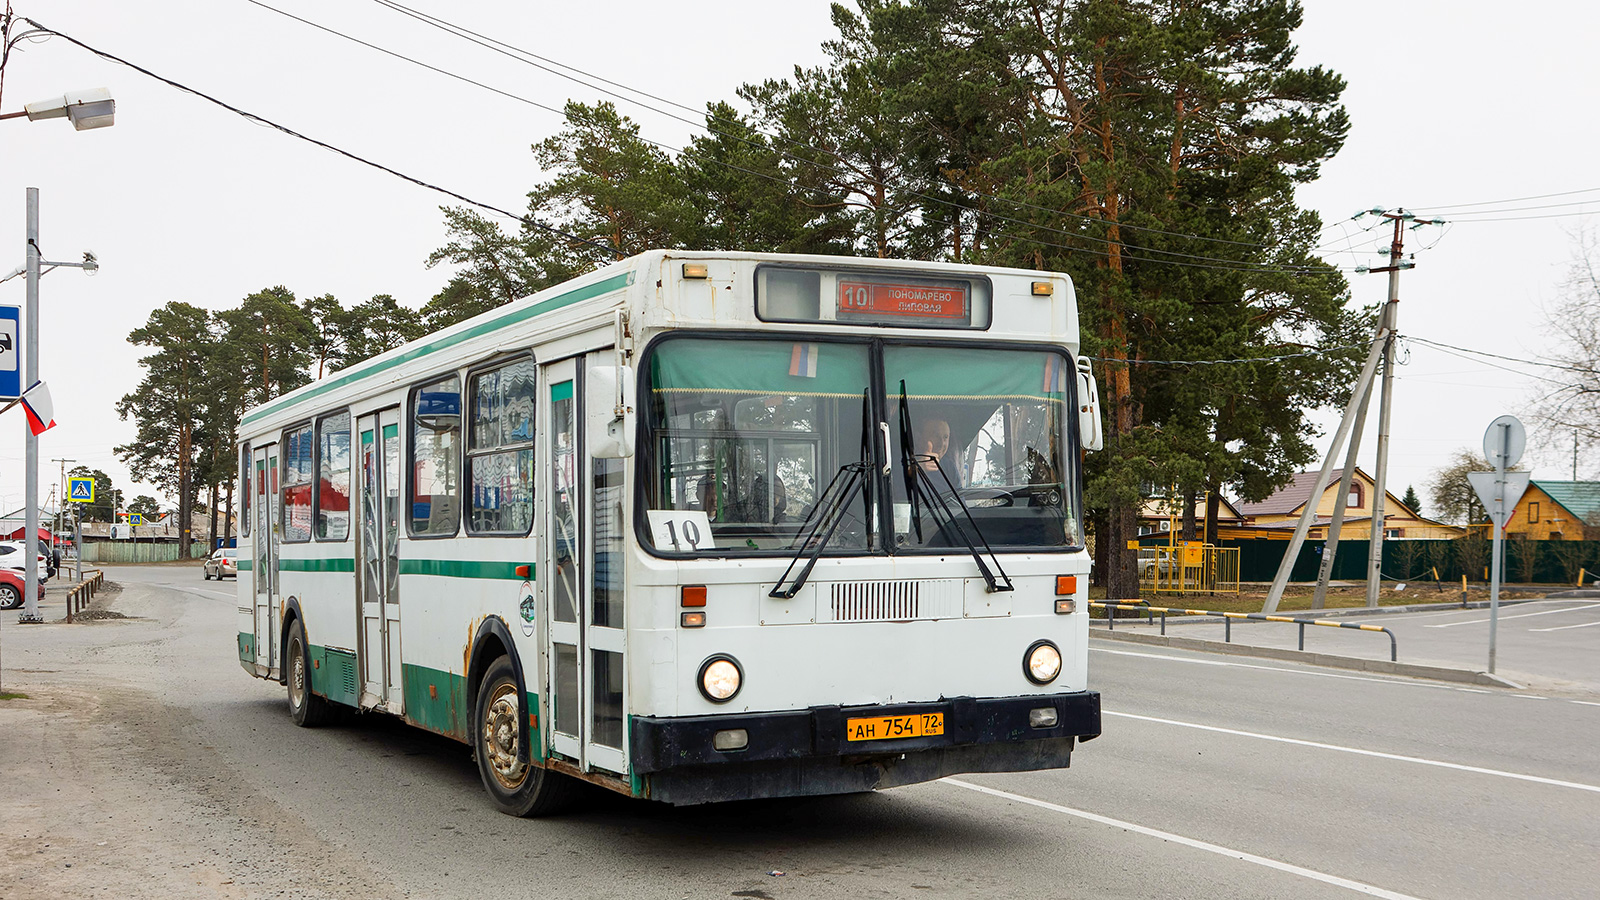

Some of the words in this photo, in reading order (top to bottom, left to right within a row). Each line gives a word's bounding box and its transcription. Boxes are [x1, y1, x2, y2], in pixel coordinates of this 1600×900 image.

[845, 287, 867, 306] 10
[888, 290, 951, 302] ПОНОМАРЕВО
[663, 520, 700, 545] 10
[855, 724, 875, 738] АН
[883, 718, 913, 736] 754
[923, 715, 938, 728] 72
